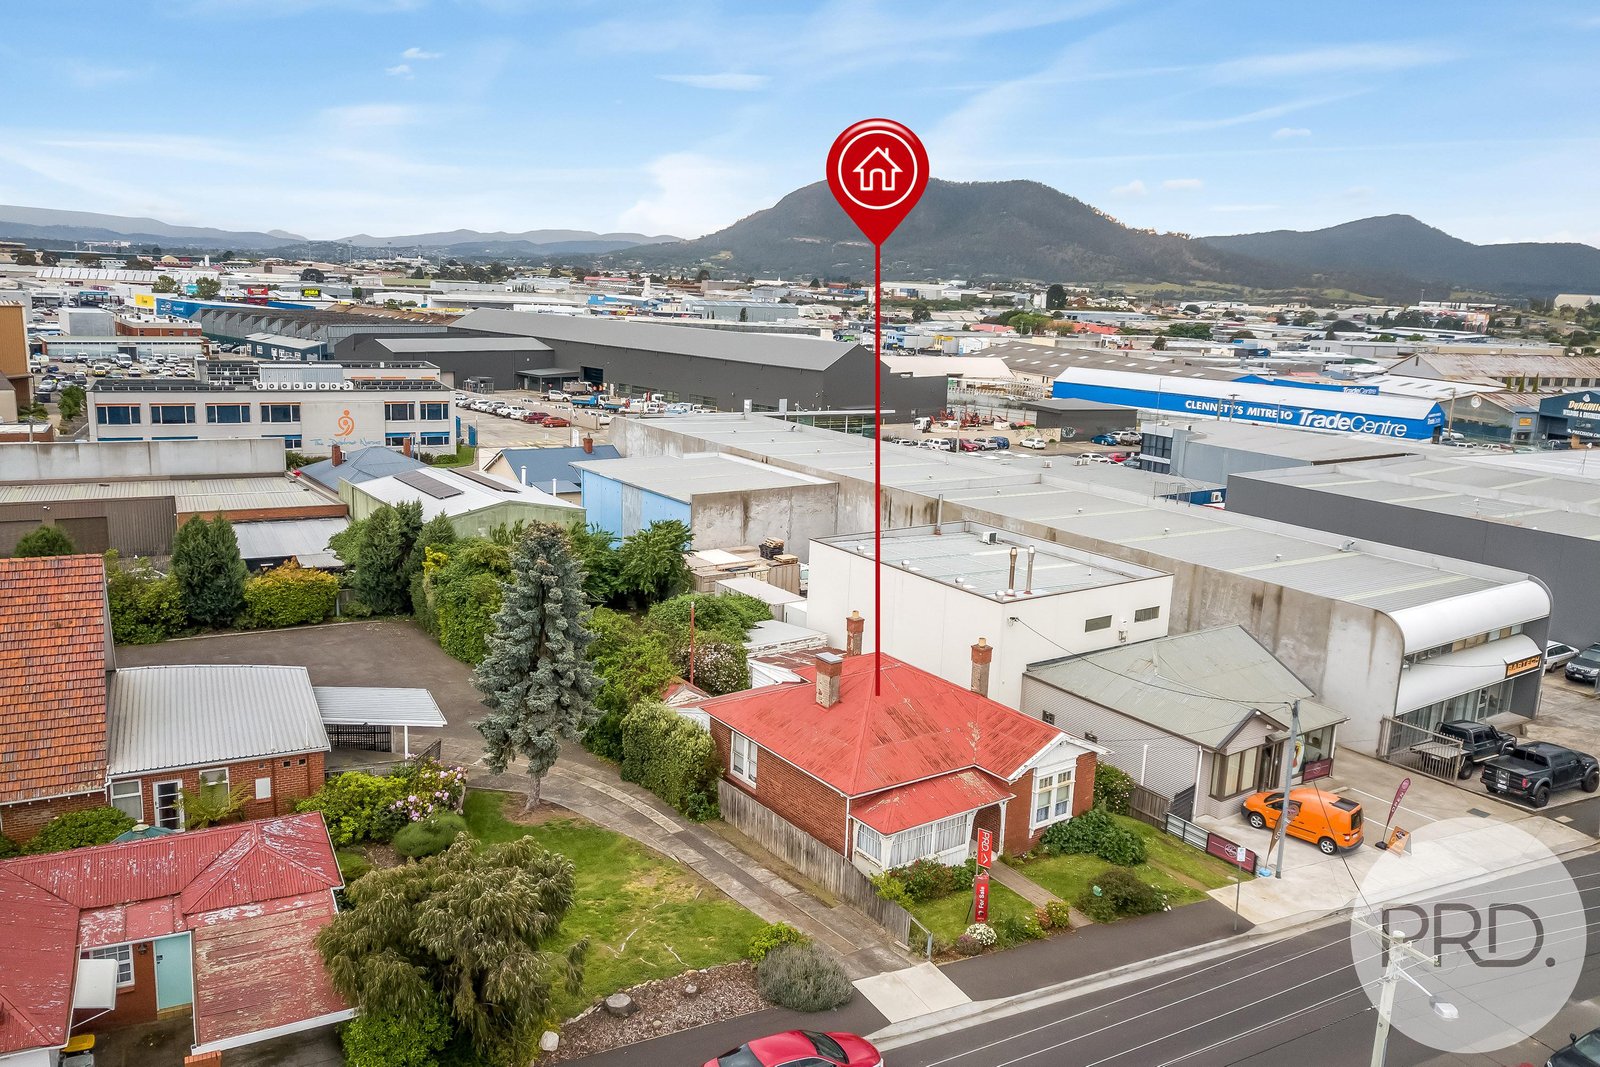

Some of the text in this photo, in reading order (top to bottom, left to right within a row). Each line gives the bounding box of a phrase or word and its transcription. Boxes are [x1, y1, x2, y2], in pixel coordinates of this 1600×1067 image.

[1342, 387, 1377, 395] TradeCentre
[1246, 407, 1278, 419] MITRE
[1280, 410, 1293, 420] 10
[1298, 409, 1407, 438] TradeCentre
[1391, 792, 1404, 813] OPEN
